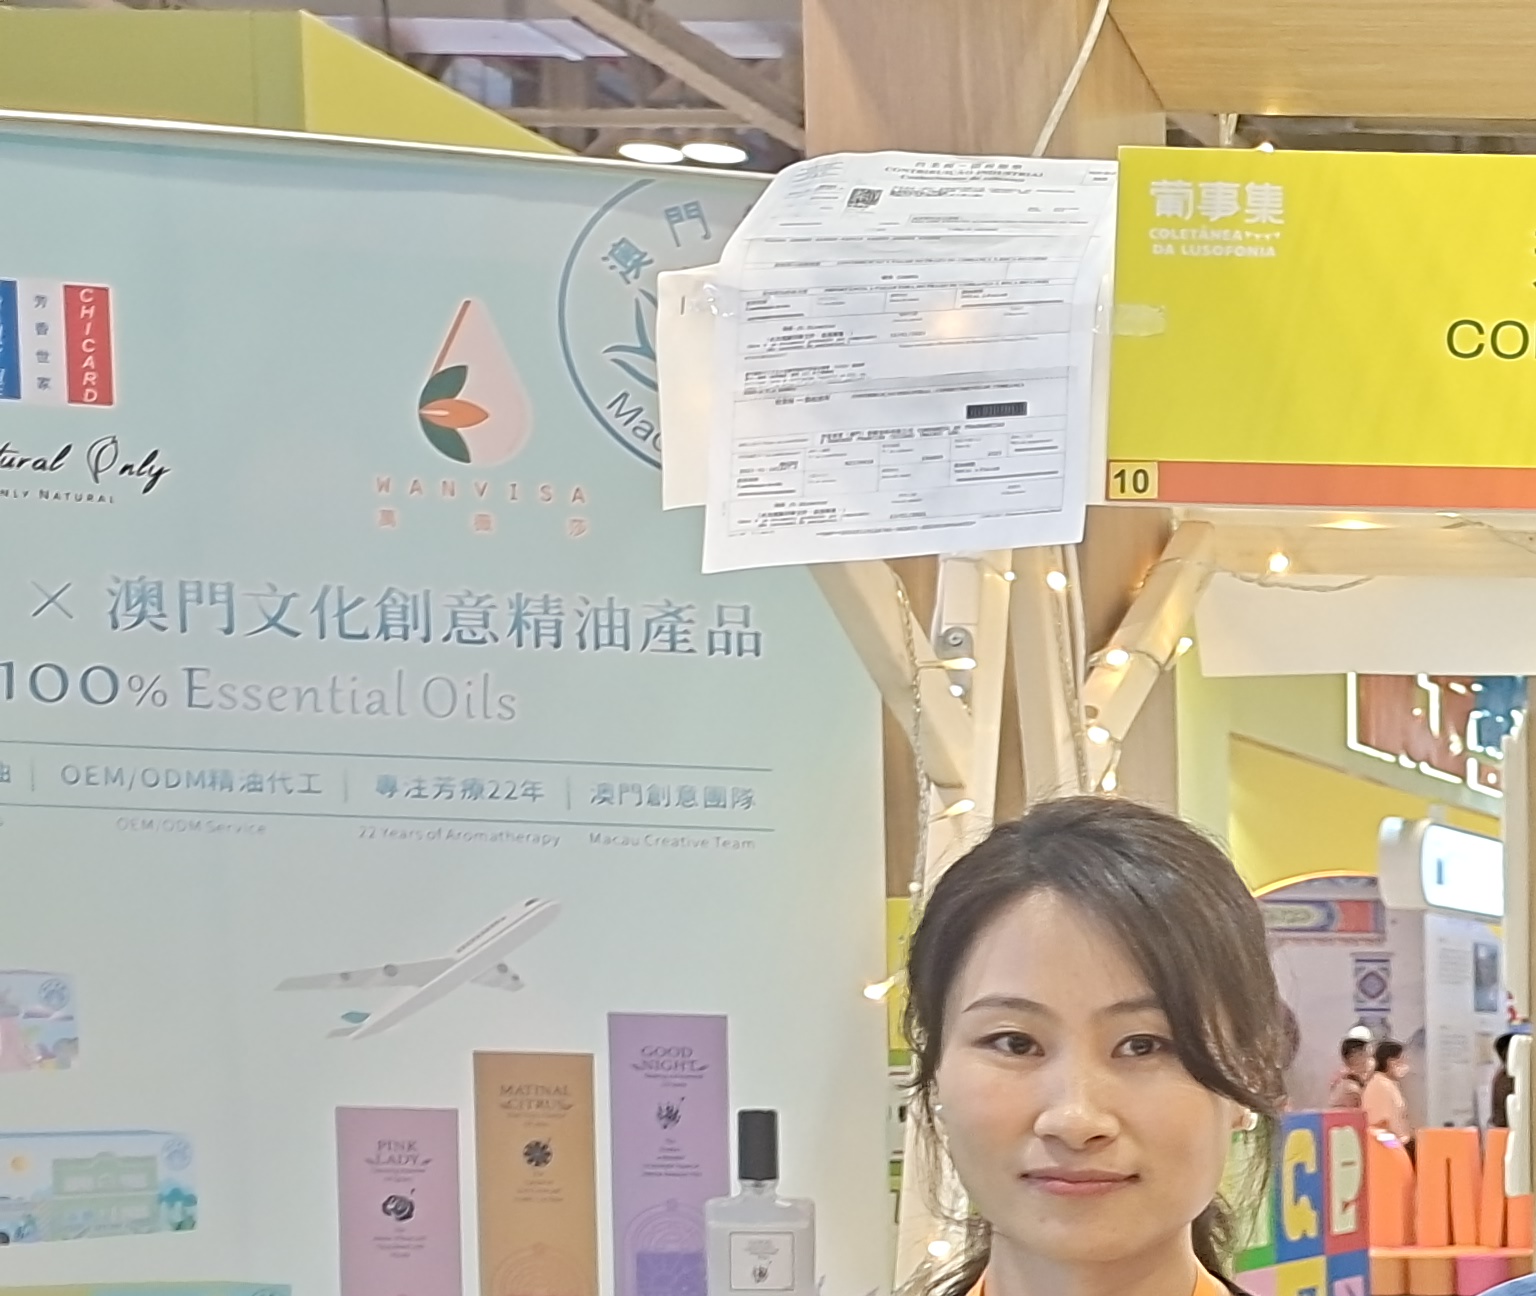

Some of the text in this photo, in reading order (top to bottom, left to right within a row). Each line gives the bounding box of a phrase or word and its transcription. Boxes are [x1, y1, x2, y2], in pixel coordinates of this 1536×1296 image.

[79, 288, 98, 402] CHICARD
[39, 489, 115, 503] NATURAL
[376, 475, 587, 504] WANVISA
[1113, 468, 1150, 494] 10
[106, 573, 764, 660] 澳門文化創意精油產品
[185, 666, 408, 718] Essential
[422, 672, 518, 723] Oils
